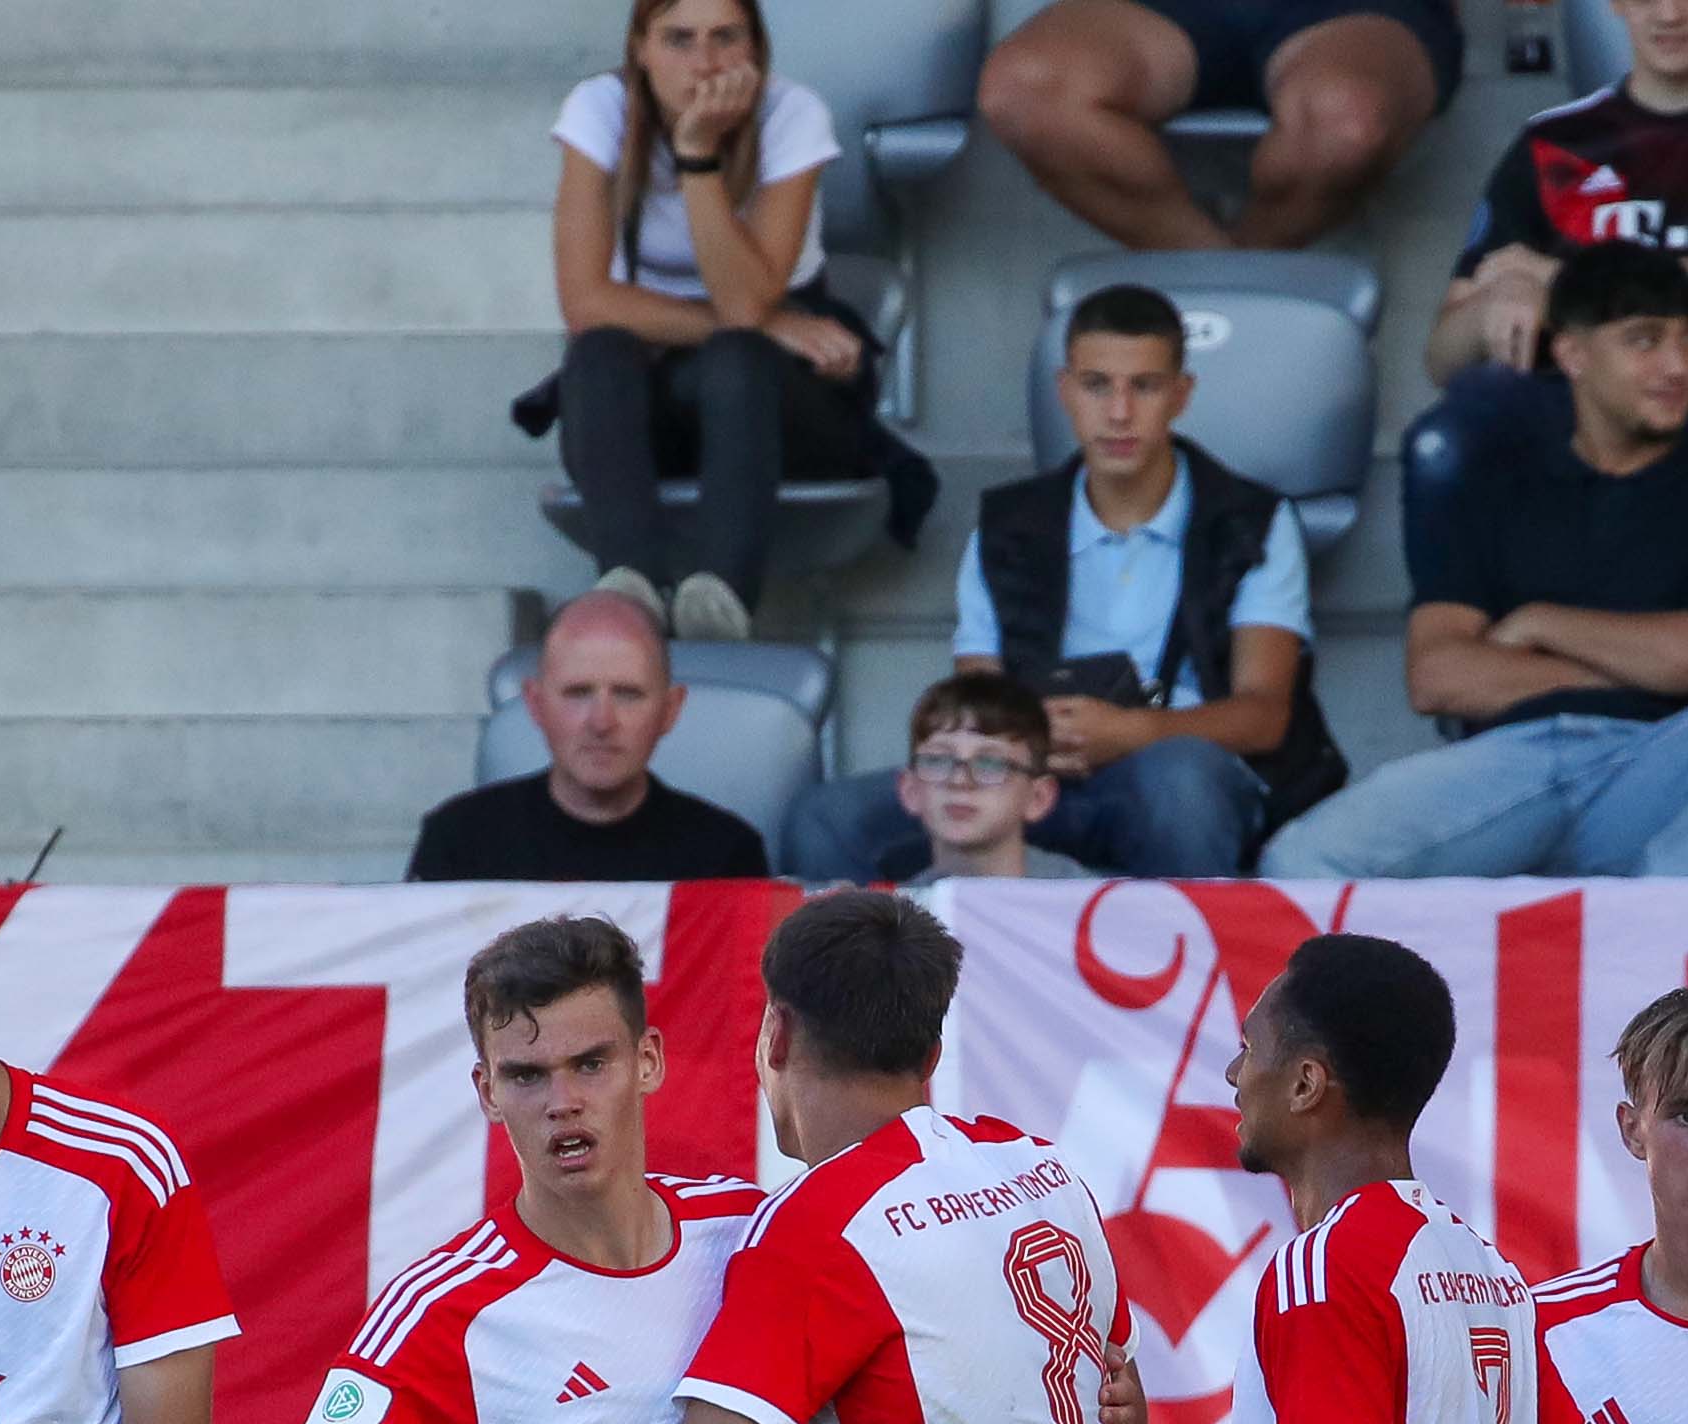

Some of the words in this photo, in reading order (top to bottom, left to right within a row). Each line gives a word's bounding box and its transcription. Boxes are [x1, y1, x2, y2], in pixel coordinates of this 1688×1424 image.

[884, 1202, 926, 1237] FC
[926, 1180, 1020, 1226] BAYERN
[1418, 1272, 1439, 1305] FC
